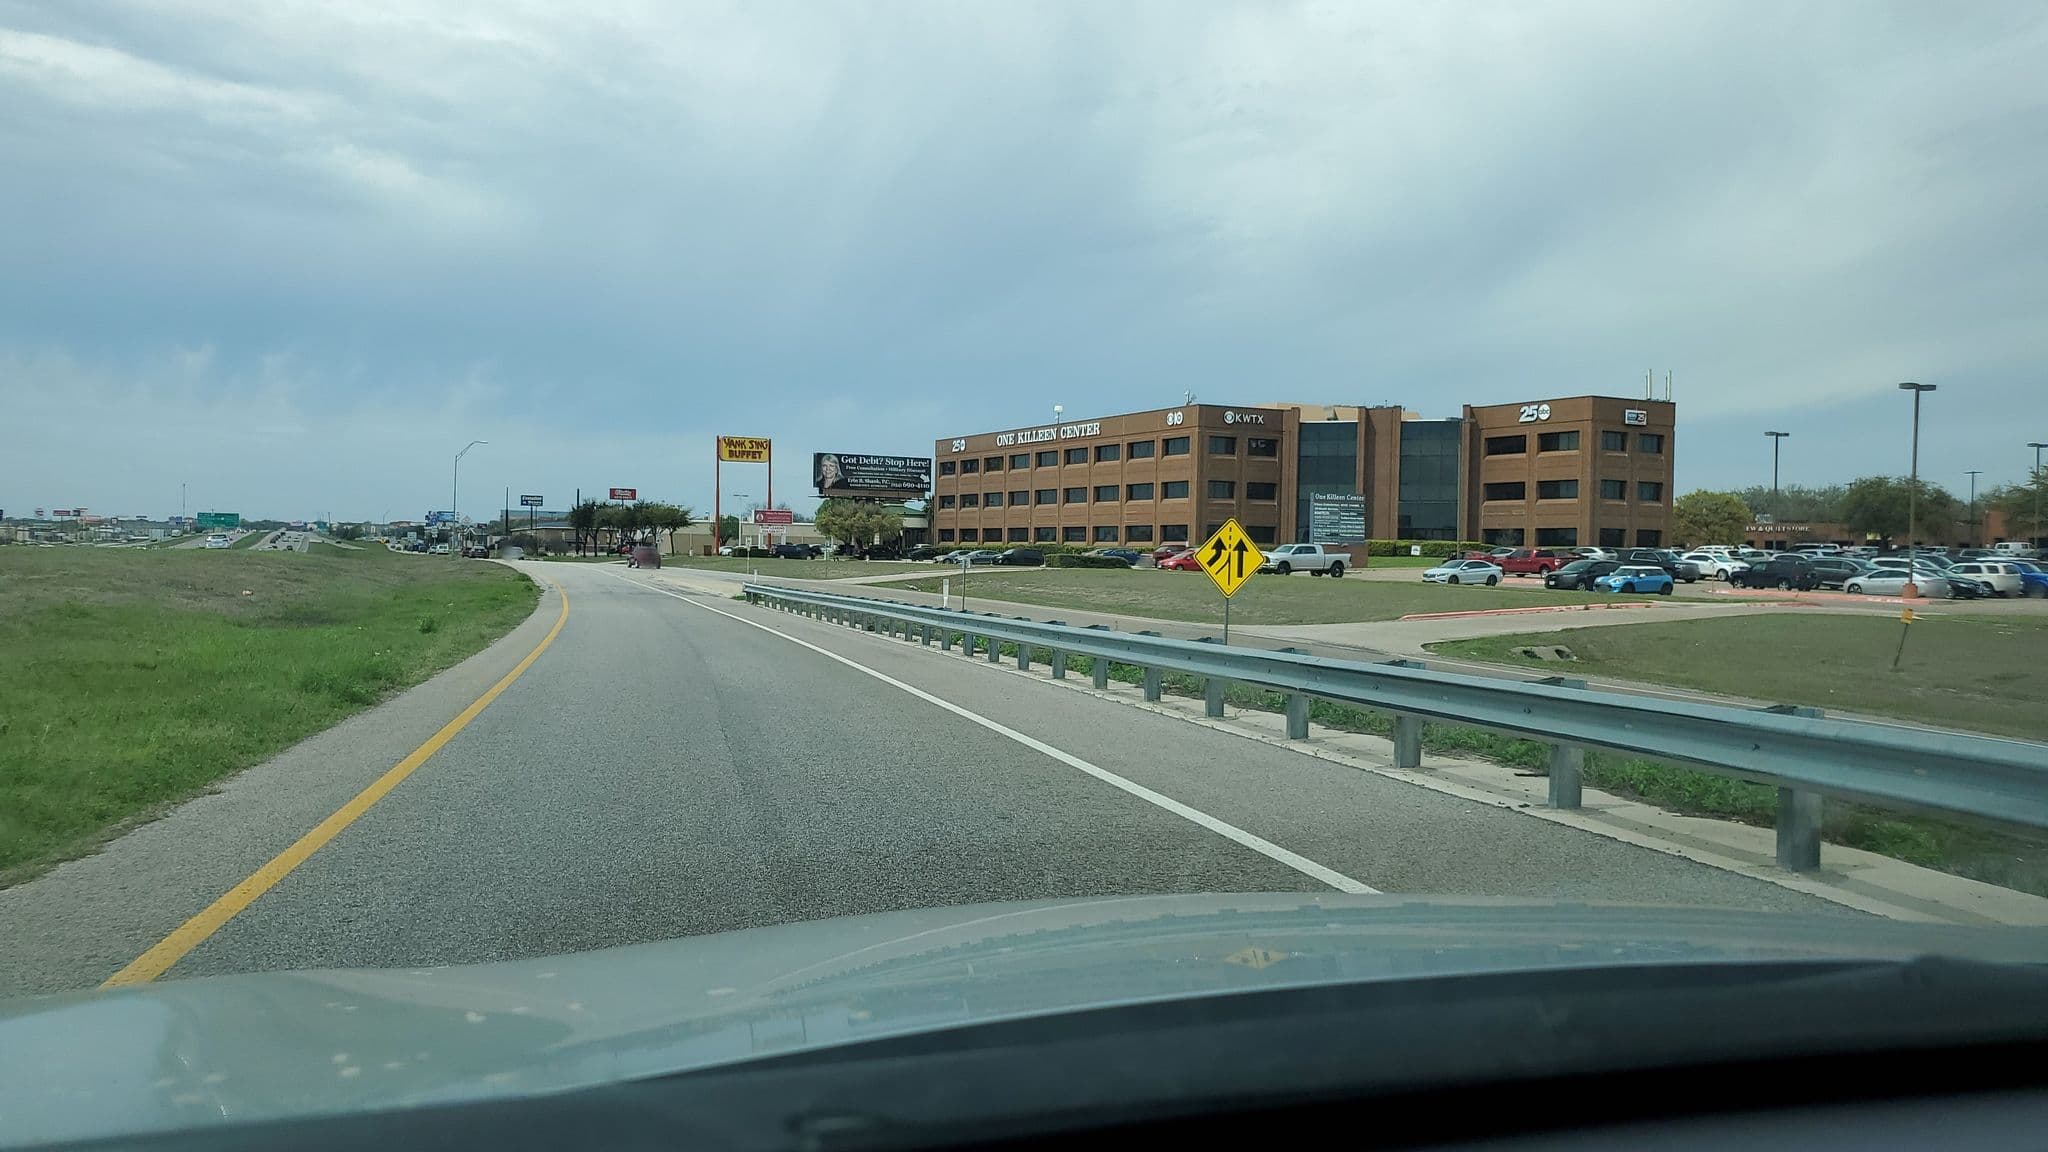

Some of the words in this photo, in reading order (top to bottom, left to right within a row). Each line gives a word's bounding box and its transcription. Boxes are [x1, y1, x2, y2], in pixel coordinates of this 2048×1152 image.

[1236, 414, 1264, 424] KWTX
[996, 434, 1014, 446] ONE
[1018, 428, 1058, 444] KILLEEN
[1060, 422, 1100, 439] CENTER
[724, 438, 746, 449] YANK
[748, 440, 768, 450] SING
[728, 450, 762, 459] BUFFET
[841, 456, 857, 464] Got
[860, 457, 884, 465] Debt?
[885, 458, 904, 467] Stop
[906, 459, 929, 467] Here!
